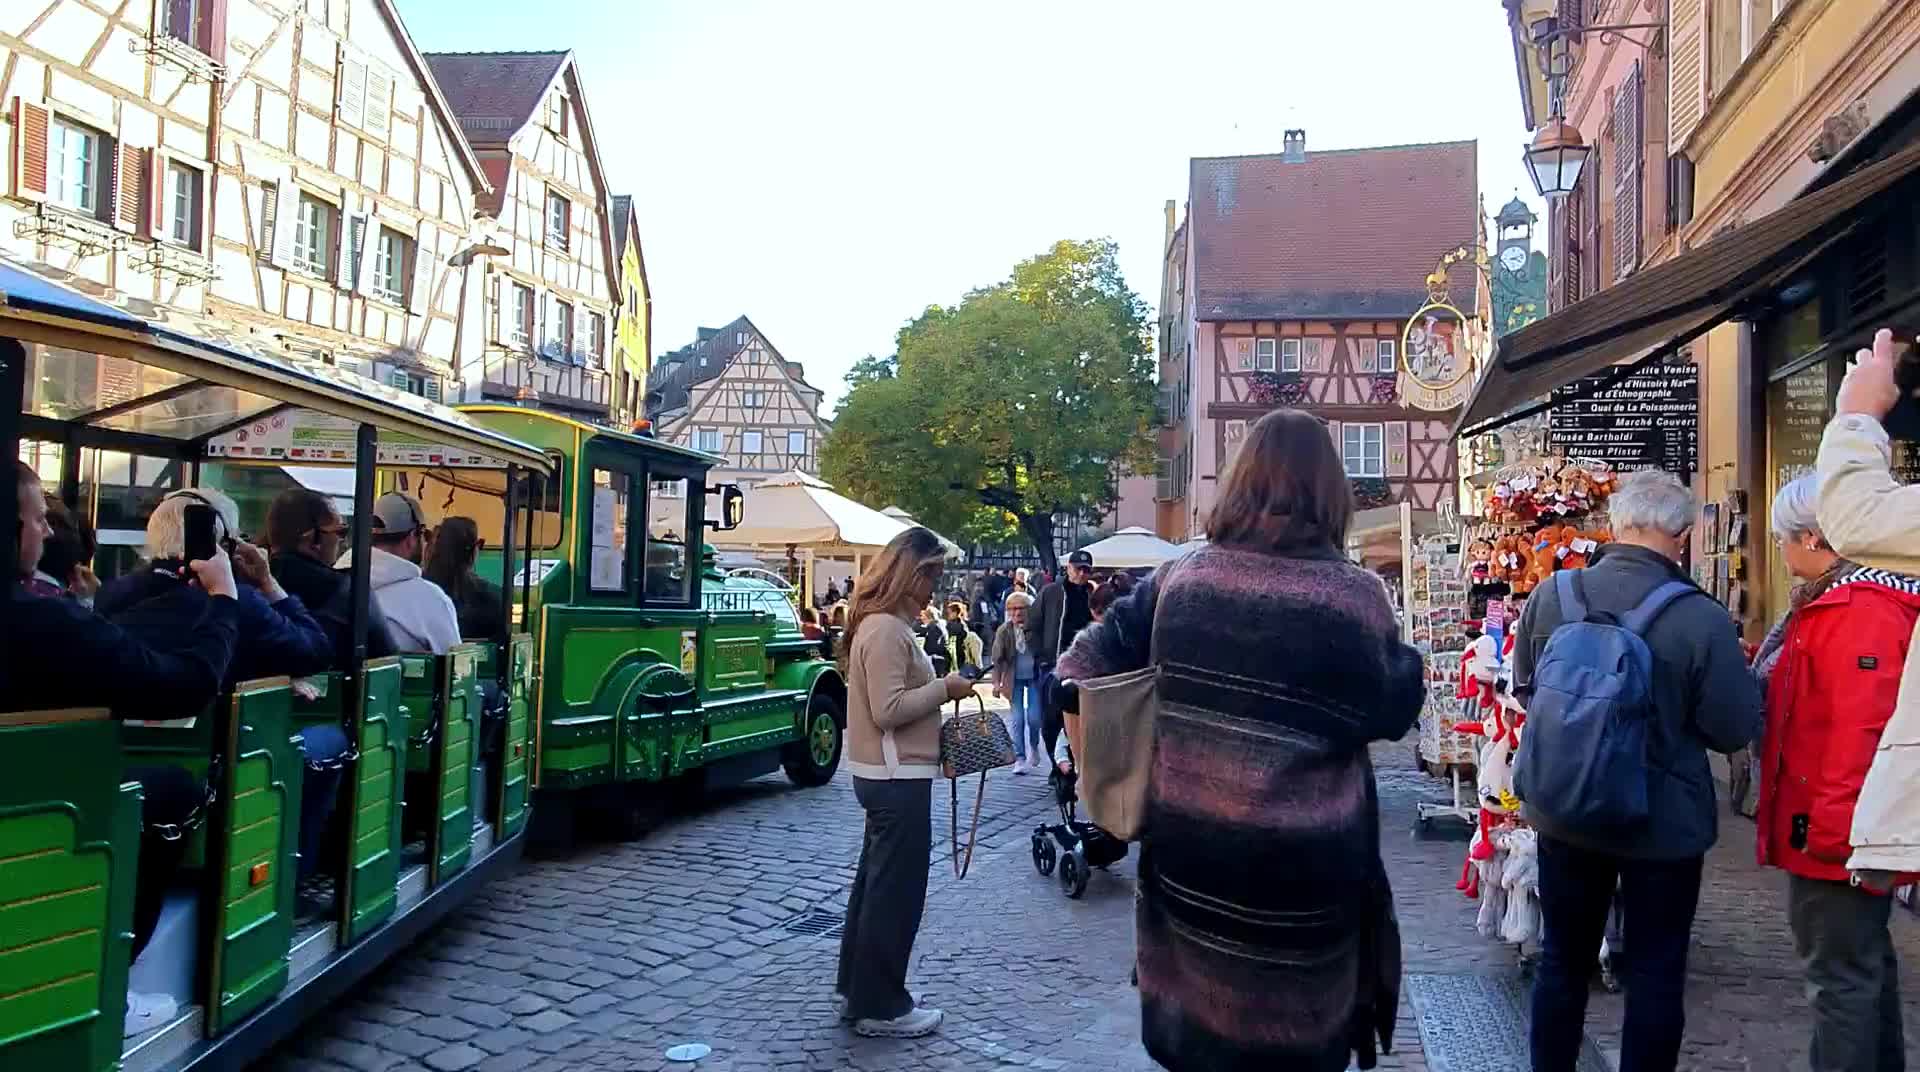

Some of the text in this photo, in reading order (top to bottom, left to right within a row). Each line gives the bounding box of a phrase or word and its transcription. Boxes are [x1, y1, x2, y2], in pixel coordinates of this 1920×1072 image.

[1663, 365, 1697, 375] Venise
[1624, 379, 1669, 389] d'Histoire
[1593, 391, 1603, 399] et
[1591, 402, 1697, 412] Quai de La Poissonnerie
[1615, 417, 1697, 426] Marché Couvert
[1552, 432, 1633, 441] Musée Bartholdi
[1569, 447, 1642, 456] Maison Pfister
